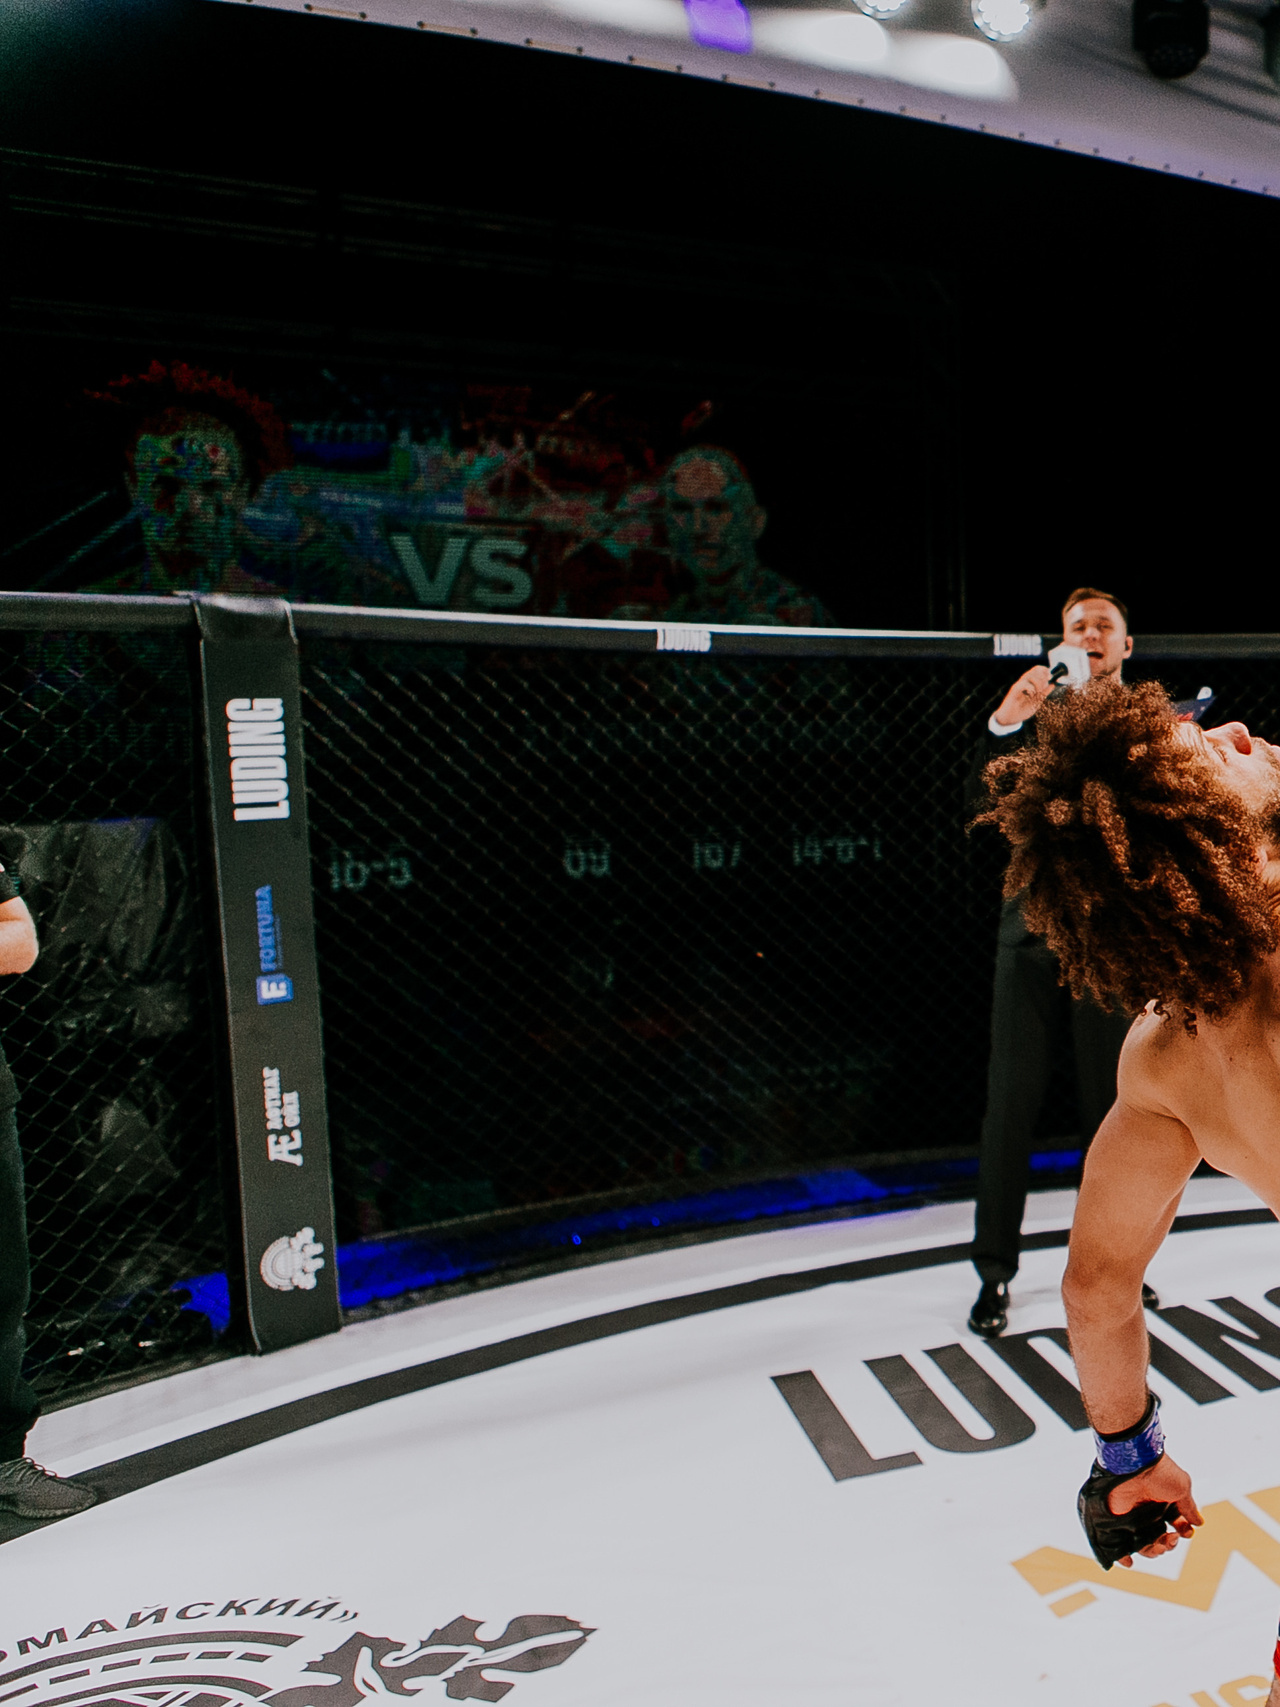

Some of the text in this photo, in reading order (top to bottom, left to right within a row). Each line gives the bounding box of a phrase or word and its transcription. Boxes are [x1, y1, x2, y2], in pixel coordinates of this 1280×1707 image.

[389, 533, 534, 608] VS
[225, 697, 291, 822] LUDING
[0, 1596, 359, 1664] МАЙСКИЙ»
